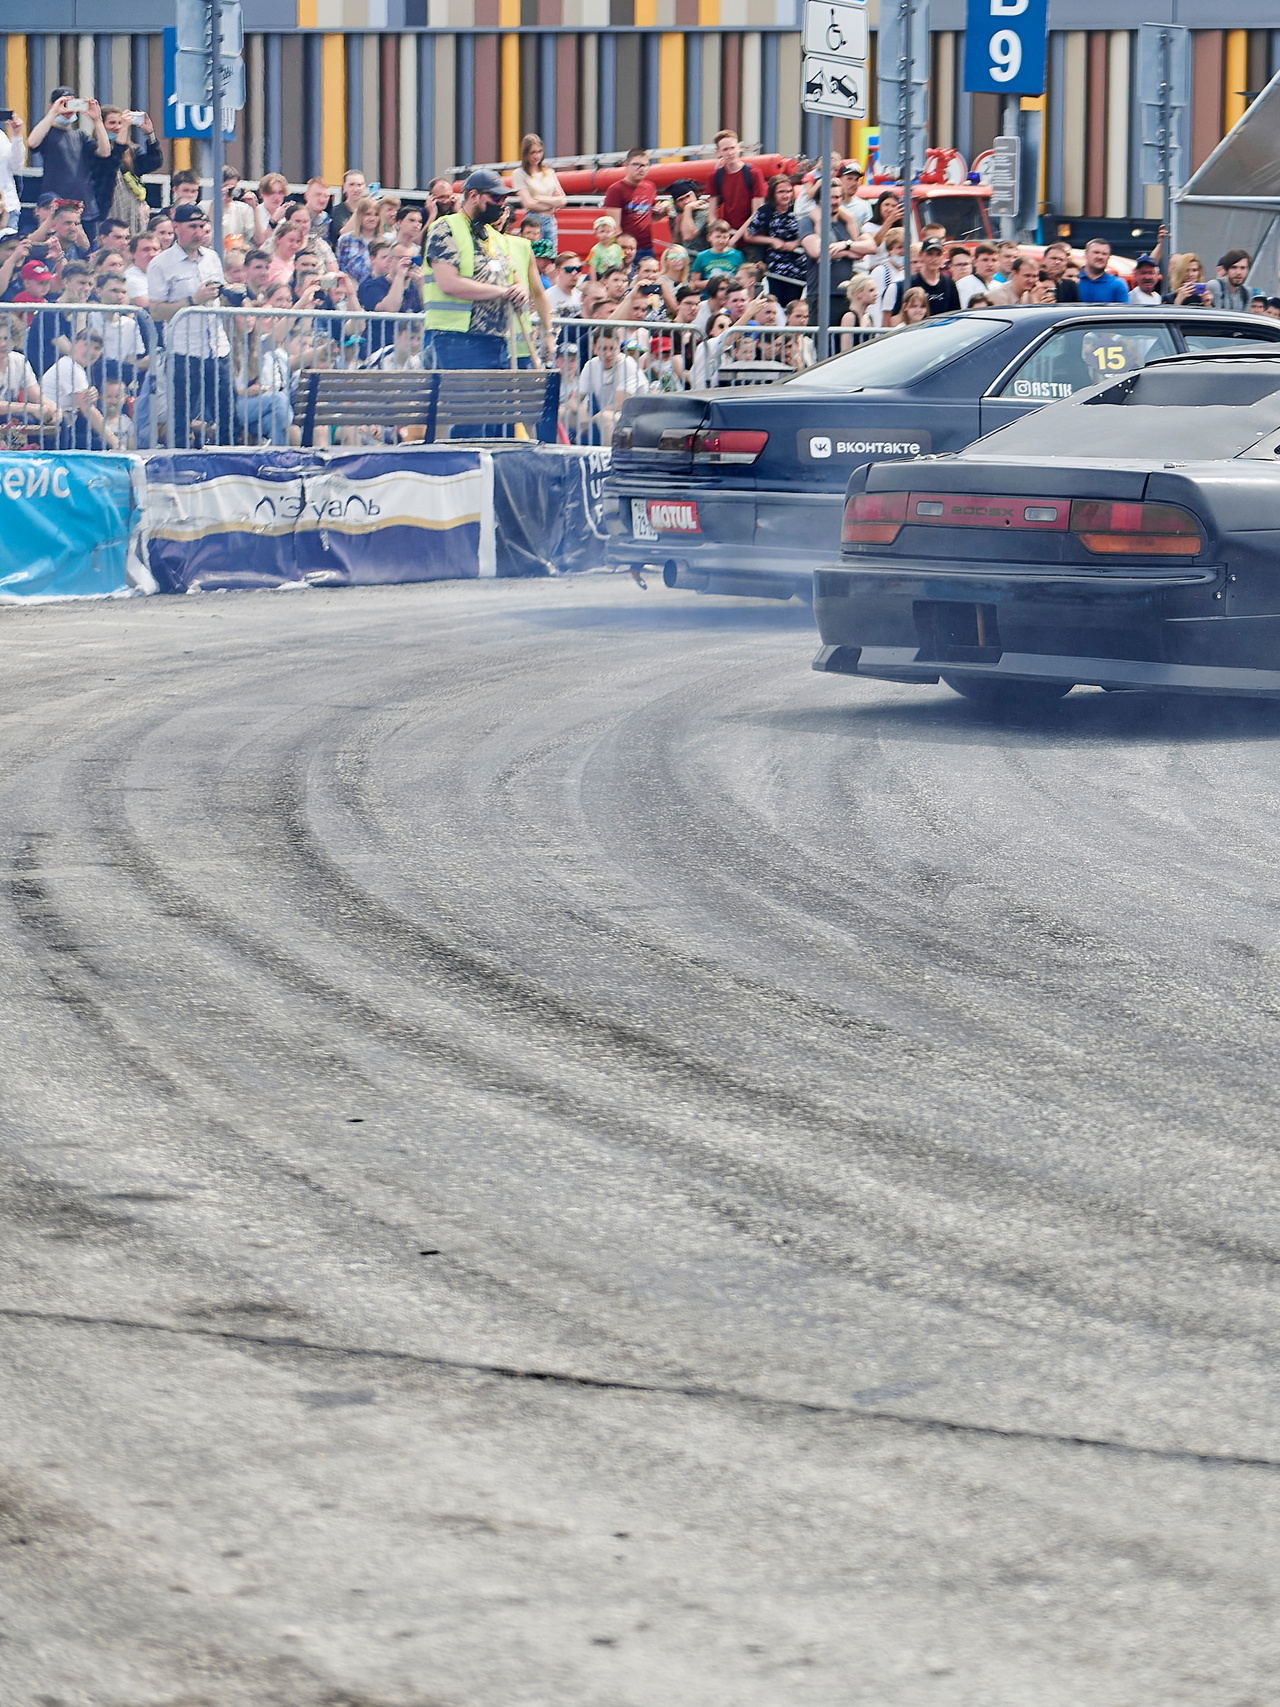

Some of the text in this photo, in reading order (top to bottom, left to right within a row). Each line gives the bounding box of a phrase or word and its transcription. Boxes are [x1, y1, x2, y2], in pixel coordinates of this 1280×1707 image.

[988, 29, 1022, 83] 9
[1093, 347, 1126, 370] 15
[836, 441, 921, 455] вконтакте
[0, 463, 70, 500] ейс
[650, 504, 698, 530] MOTUL
